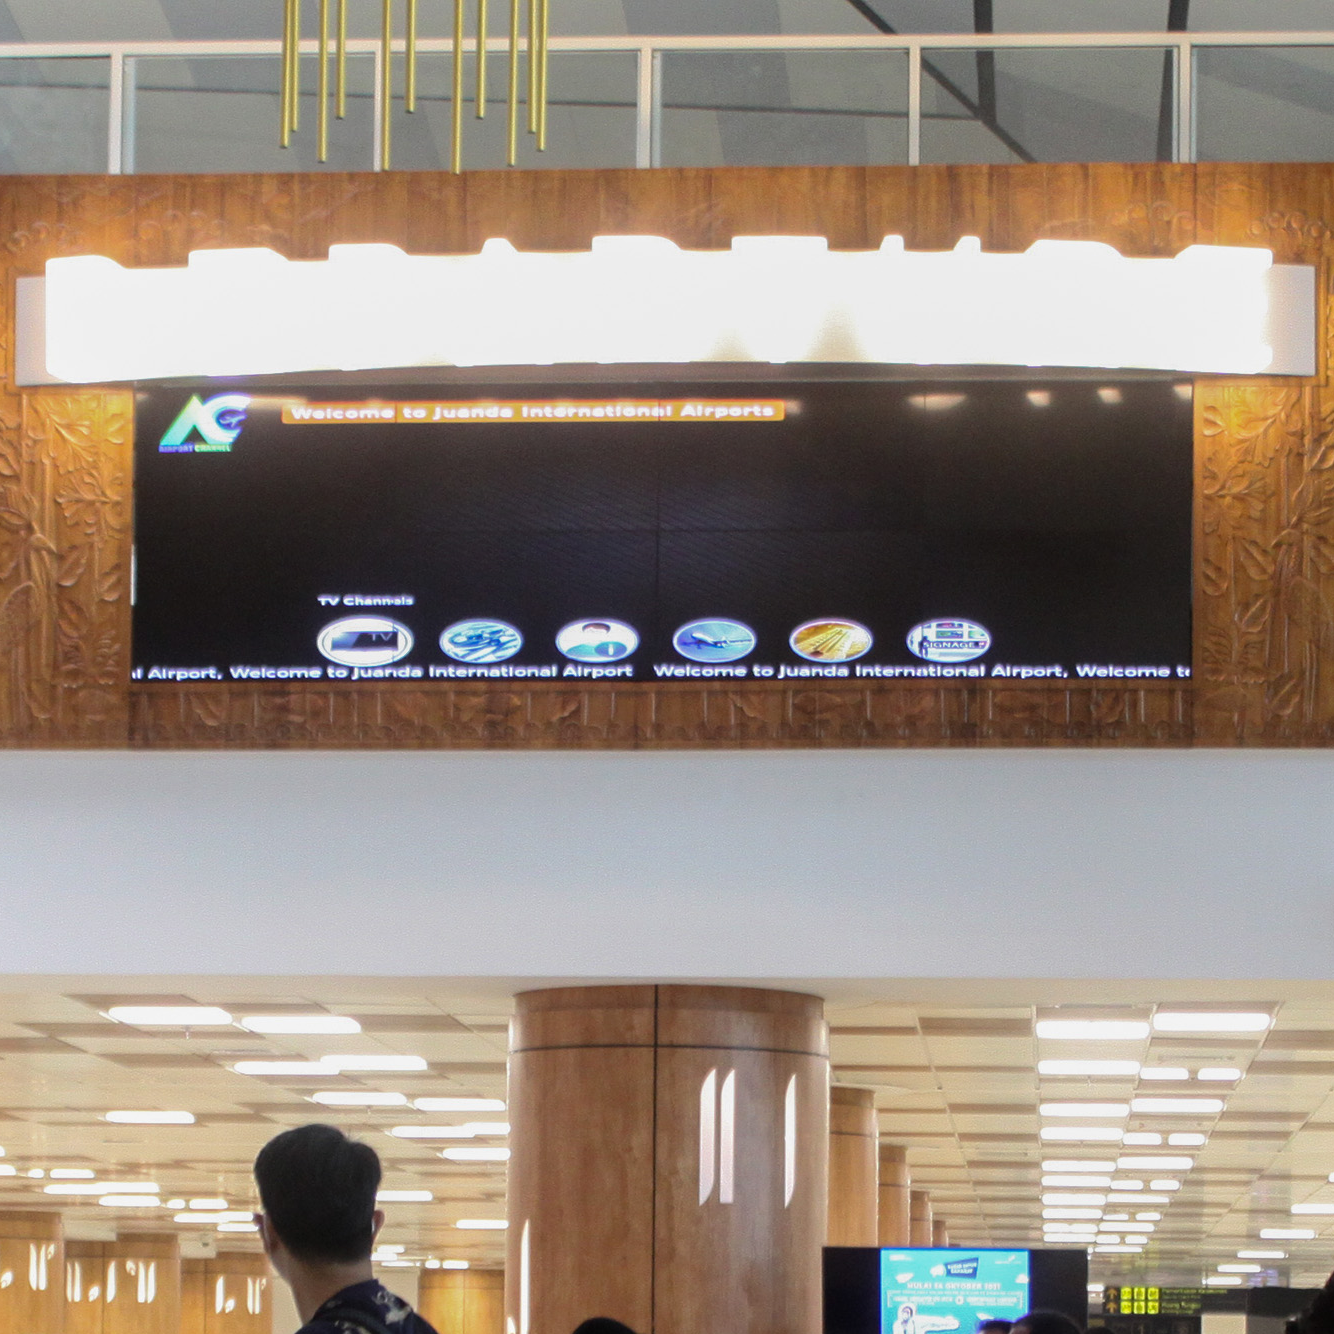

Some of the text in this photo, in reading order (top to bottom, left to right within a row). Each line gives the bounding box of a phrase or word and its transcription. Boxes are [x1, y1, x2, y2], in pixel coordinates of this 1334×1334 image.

[290, 402, 775, 421] Welcome to Juanda International Airports
[317, 594, 414, 607] TV Channels
[368, 632, 393, 643] TV
[923, 641, 975, 650] SIGNAGE
[147, 666, 223, 682] Airport,
[229, 665, 322, 680] Welcome
[326, 665, 348, 680] to
[350, 664, 423, 681] Juanda
[428, 665, 558, 679] International
[562, 663, 633, 680] Airport
[653, 664, 748, 678] Welcome
[752, 664, 774, 678] to
[777, 663, 849, 680] Juanda
[855, 663, 986, 678] International
[991, 663, 1069, 680] Airport,
[1076, 663, 1172, 678] Welcome
